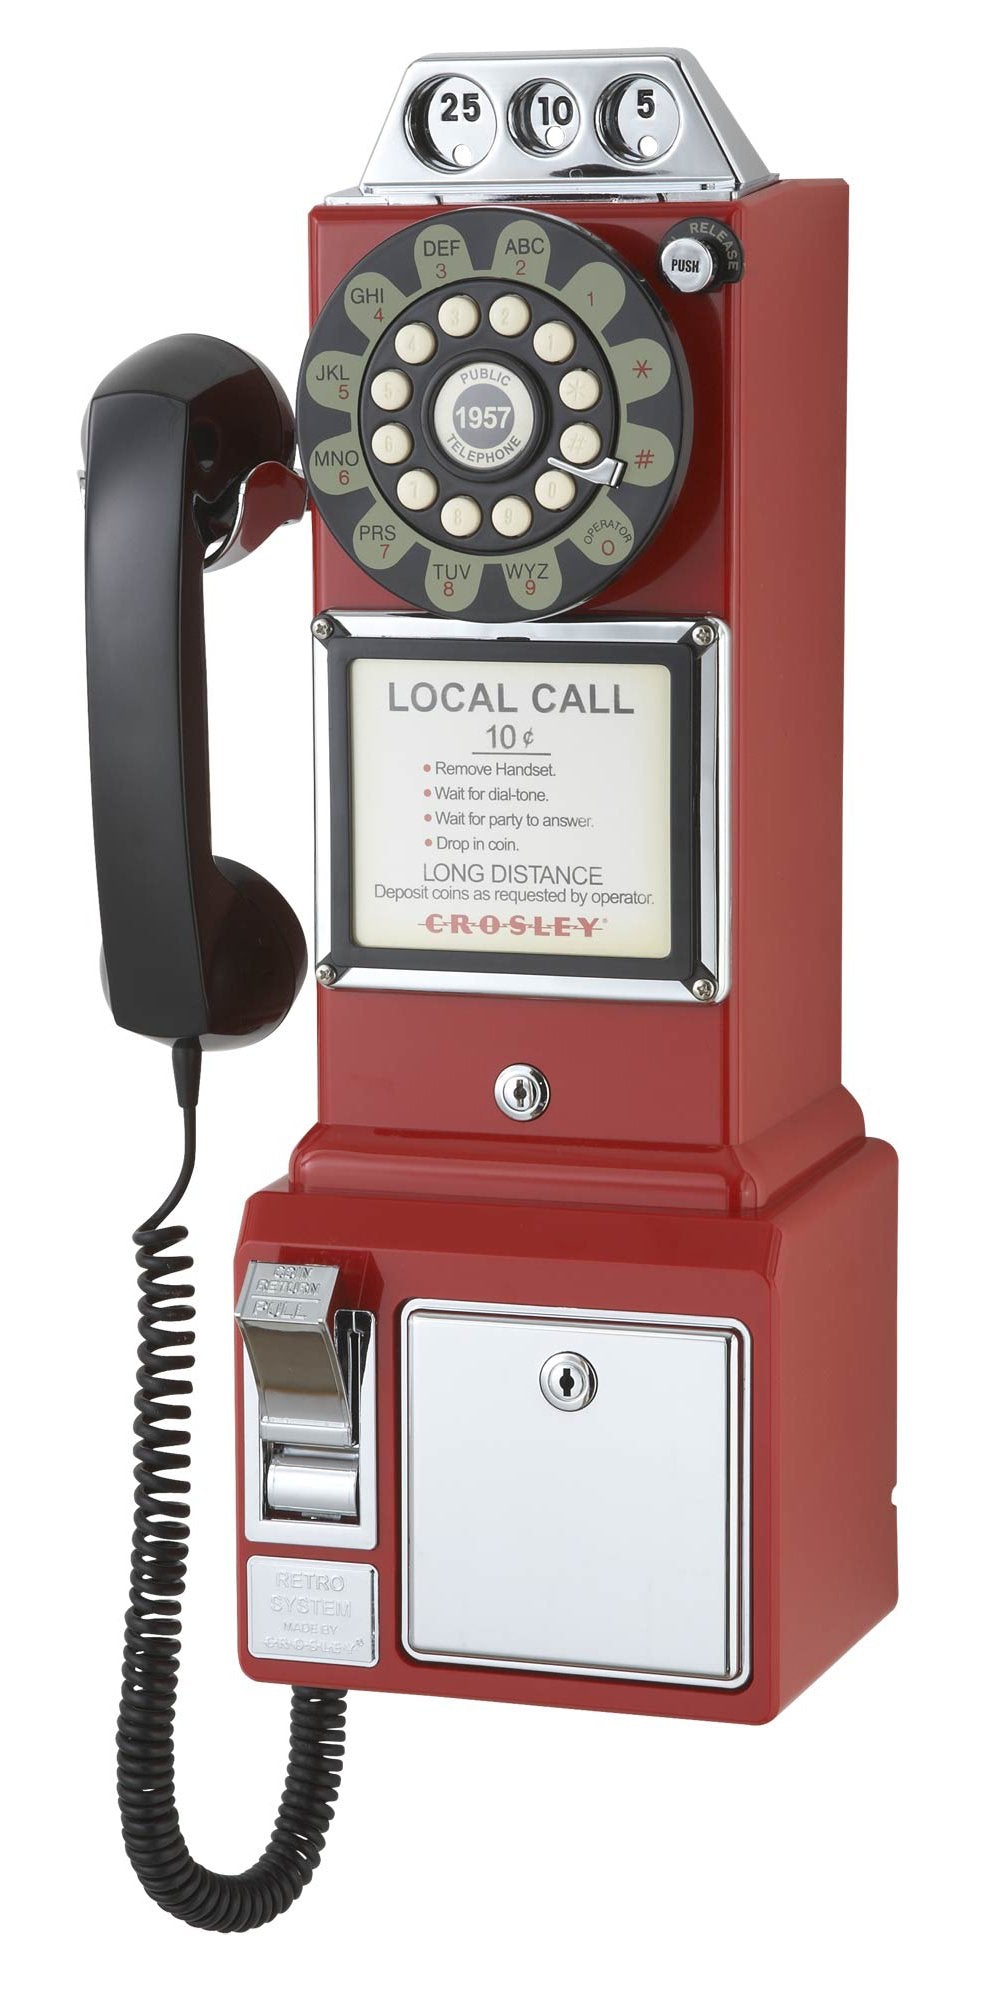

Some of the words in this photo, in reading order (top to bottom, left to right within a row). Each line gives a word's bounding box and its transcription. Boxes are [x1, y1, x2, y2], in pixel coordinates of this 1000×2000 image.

[440, 92, 481, 122] 25
[538, 96, 574, 126] 10
[636, 89, 656, 119] 5
[423, 240, 461, 256] DEF
[505, 238, 545, 255] ABC
[689, 222, 739, 270] RELEASE
[435, 263, 447, 279] 3
[515, 259, 526, 275] 2
[671, 259, 700, 273] PUSH
[350, 287, 384, 304] GHI
[587, 291, 594, 307] 1
[373, 307, 384, 323] 4
[316, 364, 350, 381] JKL
[460, 367, 511, 387] PUBLIC
[338, 384, 350, 400] 5
[455, 406, 512, 429] 1957
[446, 433, 521, 463] TELEPHONE
[315, 450, 359, 467] MNO
[338, 470, 350, 486] 6
[359, 525, 396, 541] PRS
[583, 519, 632, 545] OPERATOR
[380, 544, 390, 559] 7
[433, 564, 472, 580] TUV
[505, 563, 549, 579] WYZ
[443, 581, 454, 597] 8
[525, 580, 536, 595] 9
[388, 682, 518, 713] LOCAL
[532, 683, 635, 714] CALL
[485, 724, 517, 749] 10
[435, 761, 492, 776] Remove
[496, 762, 556, 777] Handset.
[435, 786, 465, 801] Wait
[467, 786, 486, 801] for
[488, 787, 549, 802] dial-tone.
[435, 811, 466, 826] Wait
[468, 812, 486, 827] for
[489, 813, 522, 830] party
[526, 814, 540, 828] to
[543, 815, 594, 828] answer.
[437, 836, 470, 853] Drop
[473, 837, 485, 851] in
[488, 837, 519, 851] coin.
[423, 863, 485, 883] LONG
[491, 864, 603, 886] DISTANCE
[374, 884, 428, 902] Deposit
[432, 886, 468, 900] coins
[473, 889, 491, 901] as
[494, 887, 567, 905] requested
[570, 889, 588, 907] by
[591, 891, 655, 907] operator.
[256, 1278, 321, 1296] RETURN
[253, 1299, 307, 1320] PULL
[275, 1572, 345, 1592] RETRO
[270, 1594, 352, 1618] SYSTEM
[283, 1622, 319, 1635] MADE
[321, 1624, 338, 1635] BY
